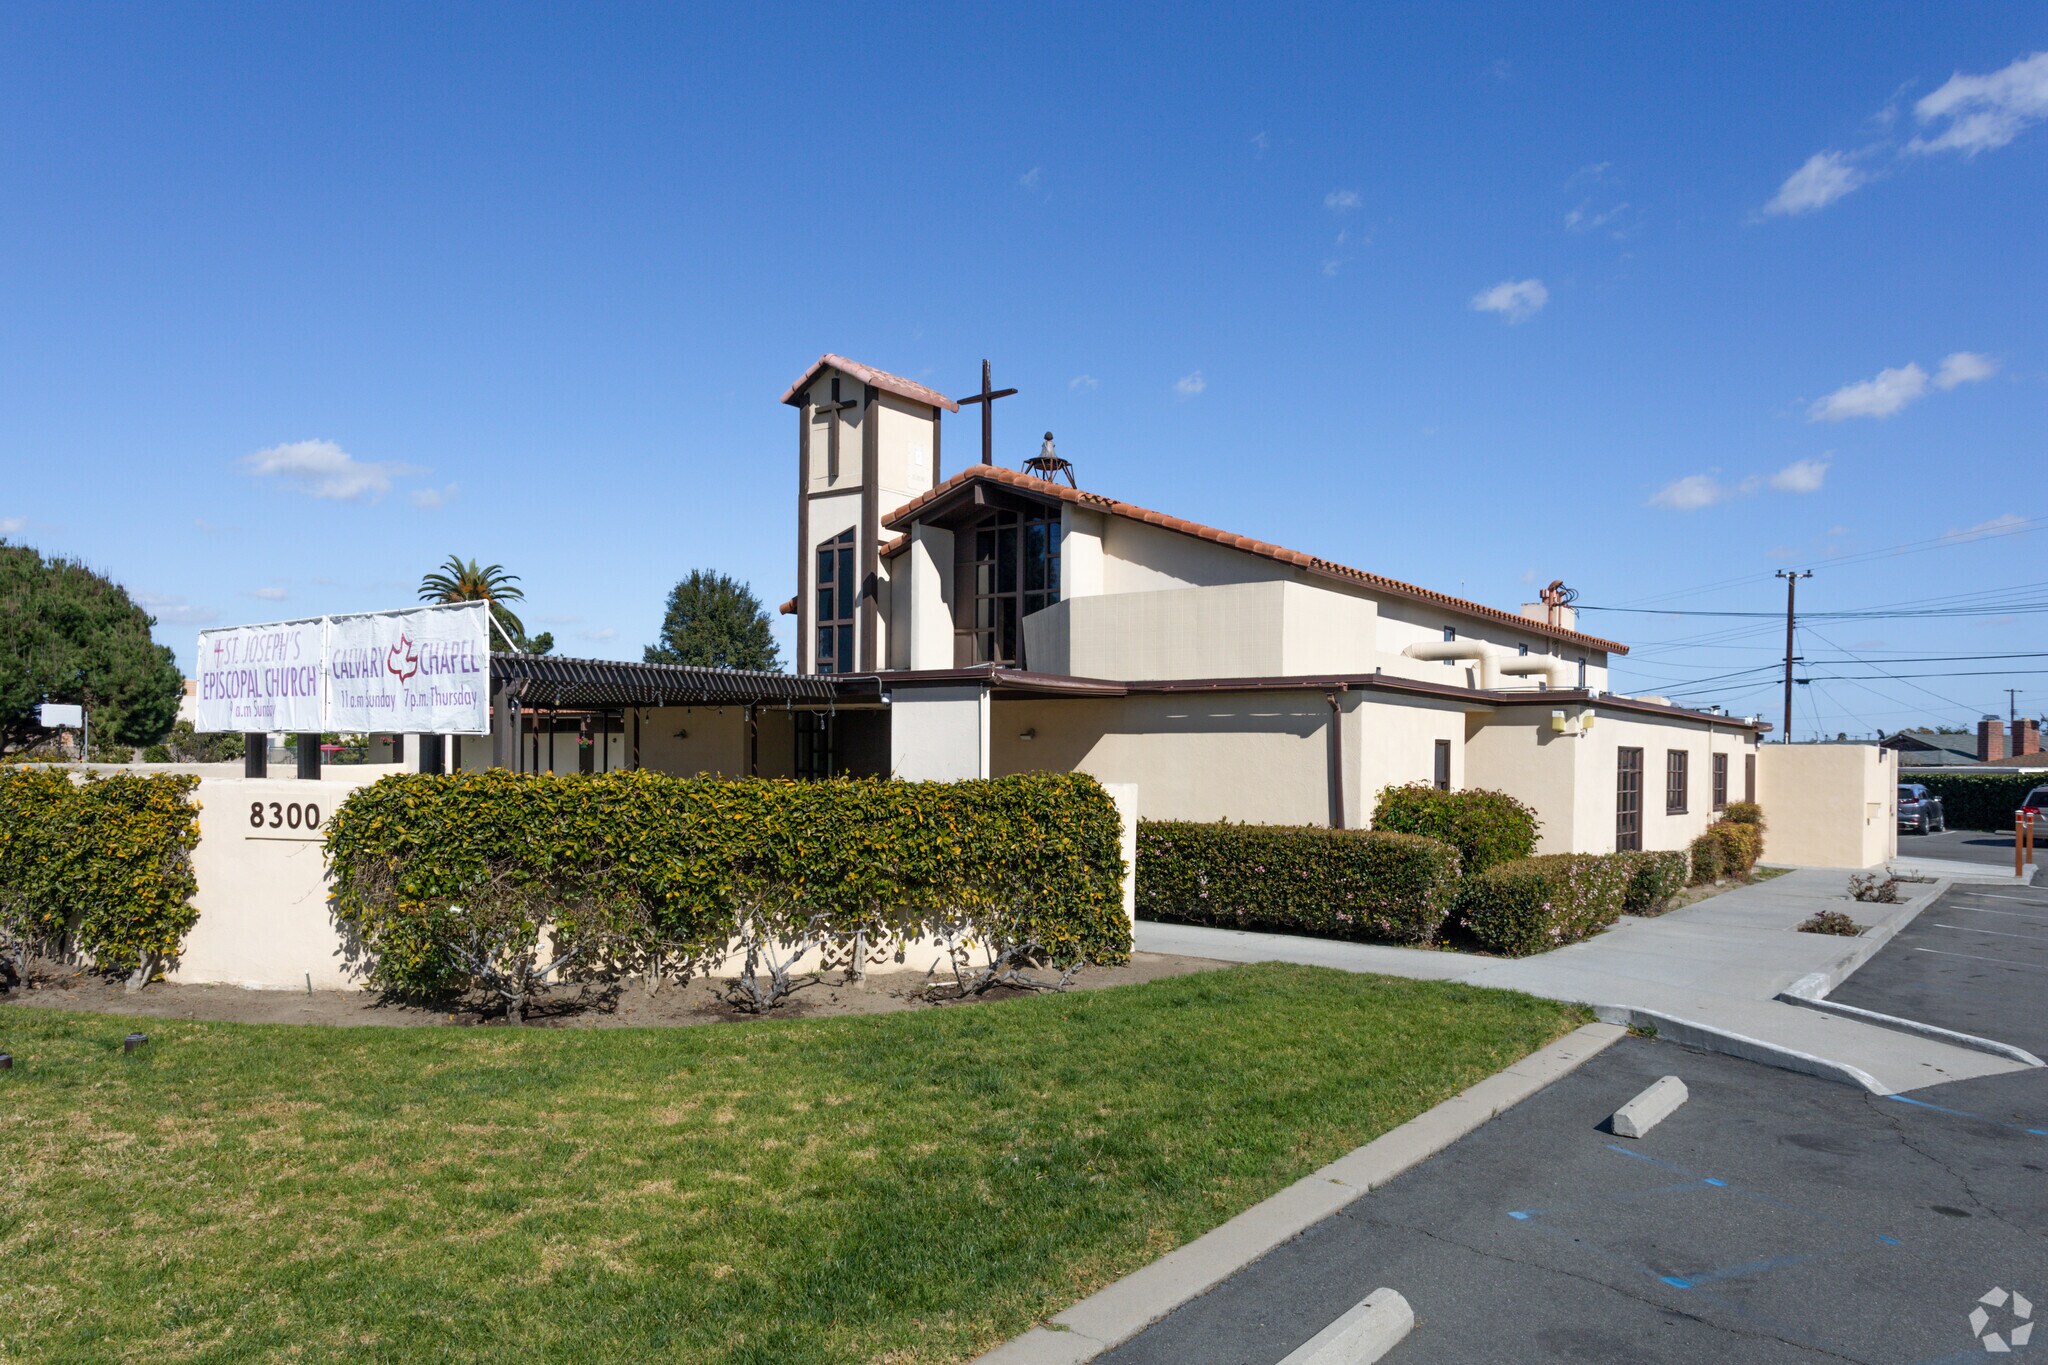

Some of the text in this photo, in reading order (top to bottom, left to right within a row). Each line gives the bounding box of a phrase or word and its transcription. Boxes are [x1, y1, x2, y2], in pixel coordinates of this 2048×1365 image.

[224, 630, 301, 665] ST. JOSEPH'S
[332, 639, 480, 680] CALVARY CHAPEL
[203, 665, 317, 701] EPISCOPAL CHURCH
[365, 688, 396, 712] Sunday
[430, 684, 477, 710] Thursday
[250, 801, 320, 830] 8300
